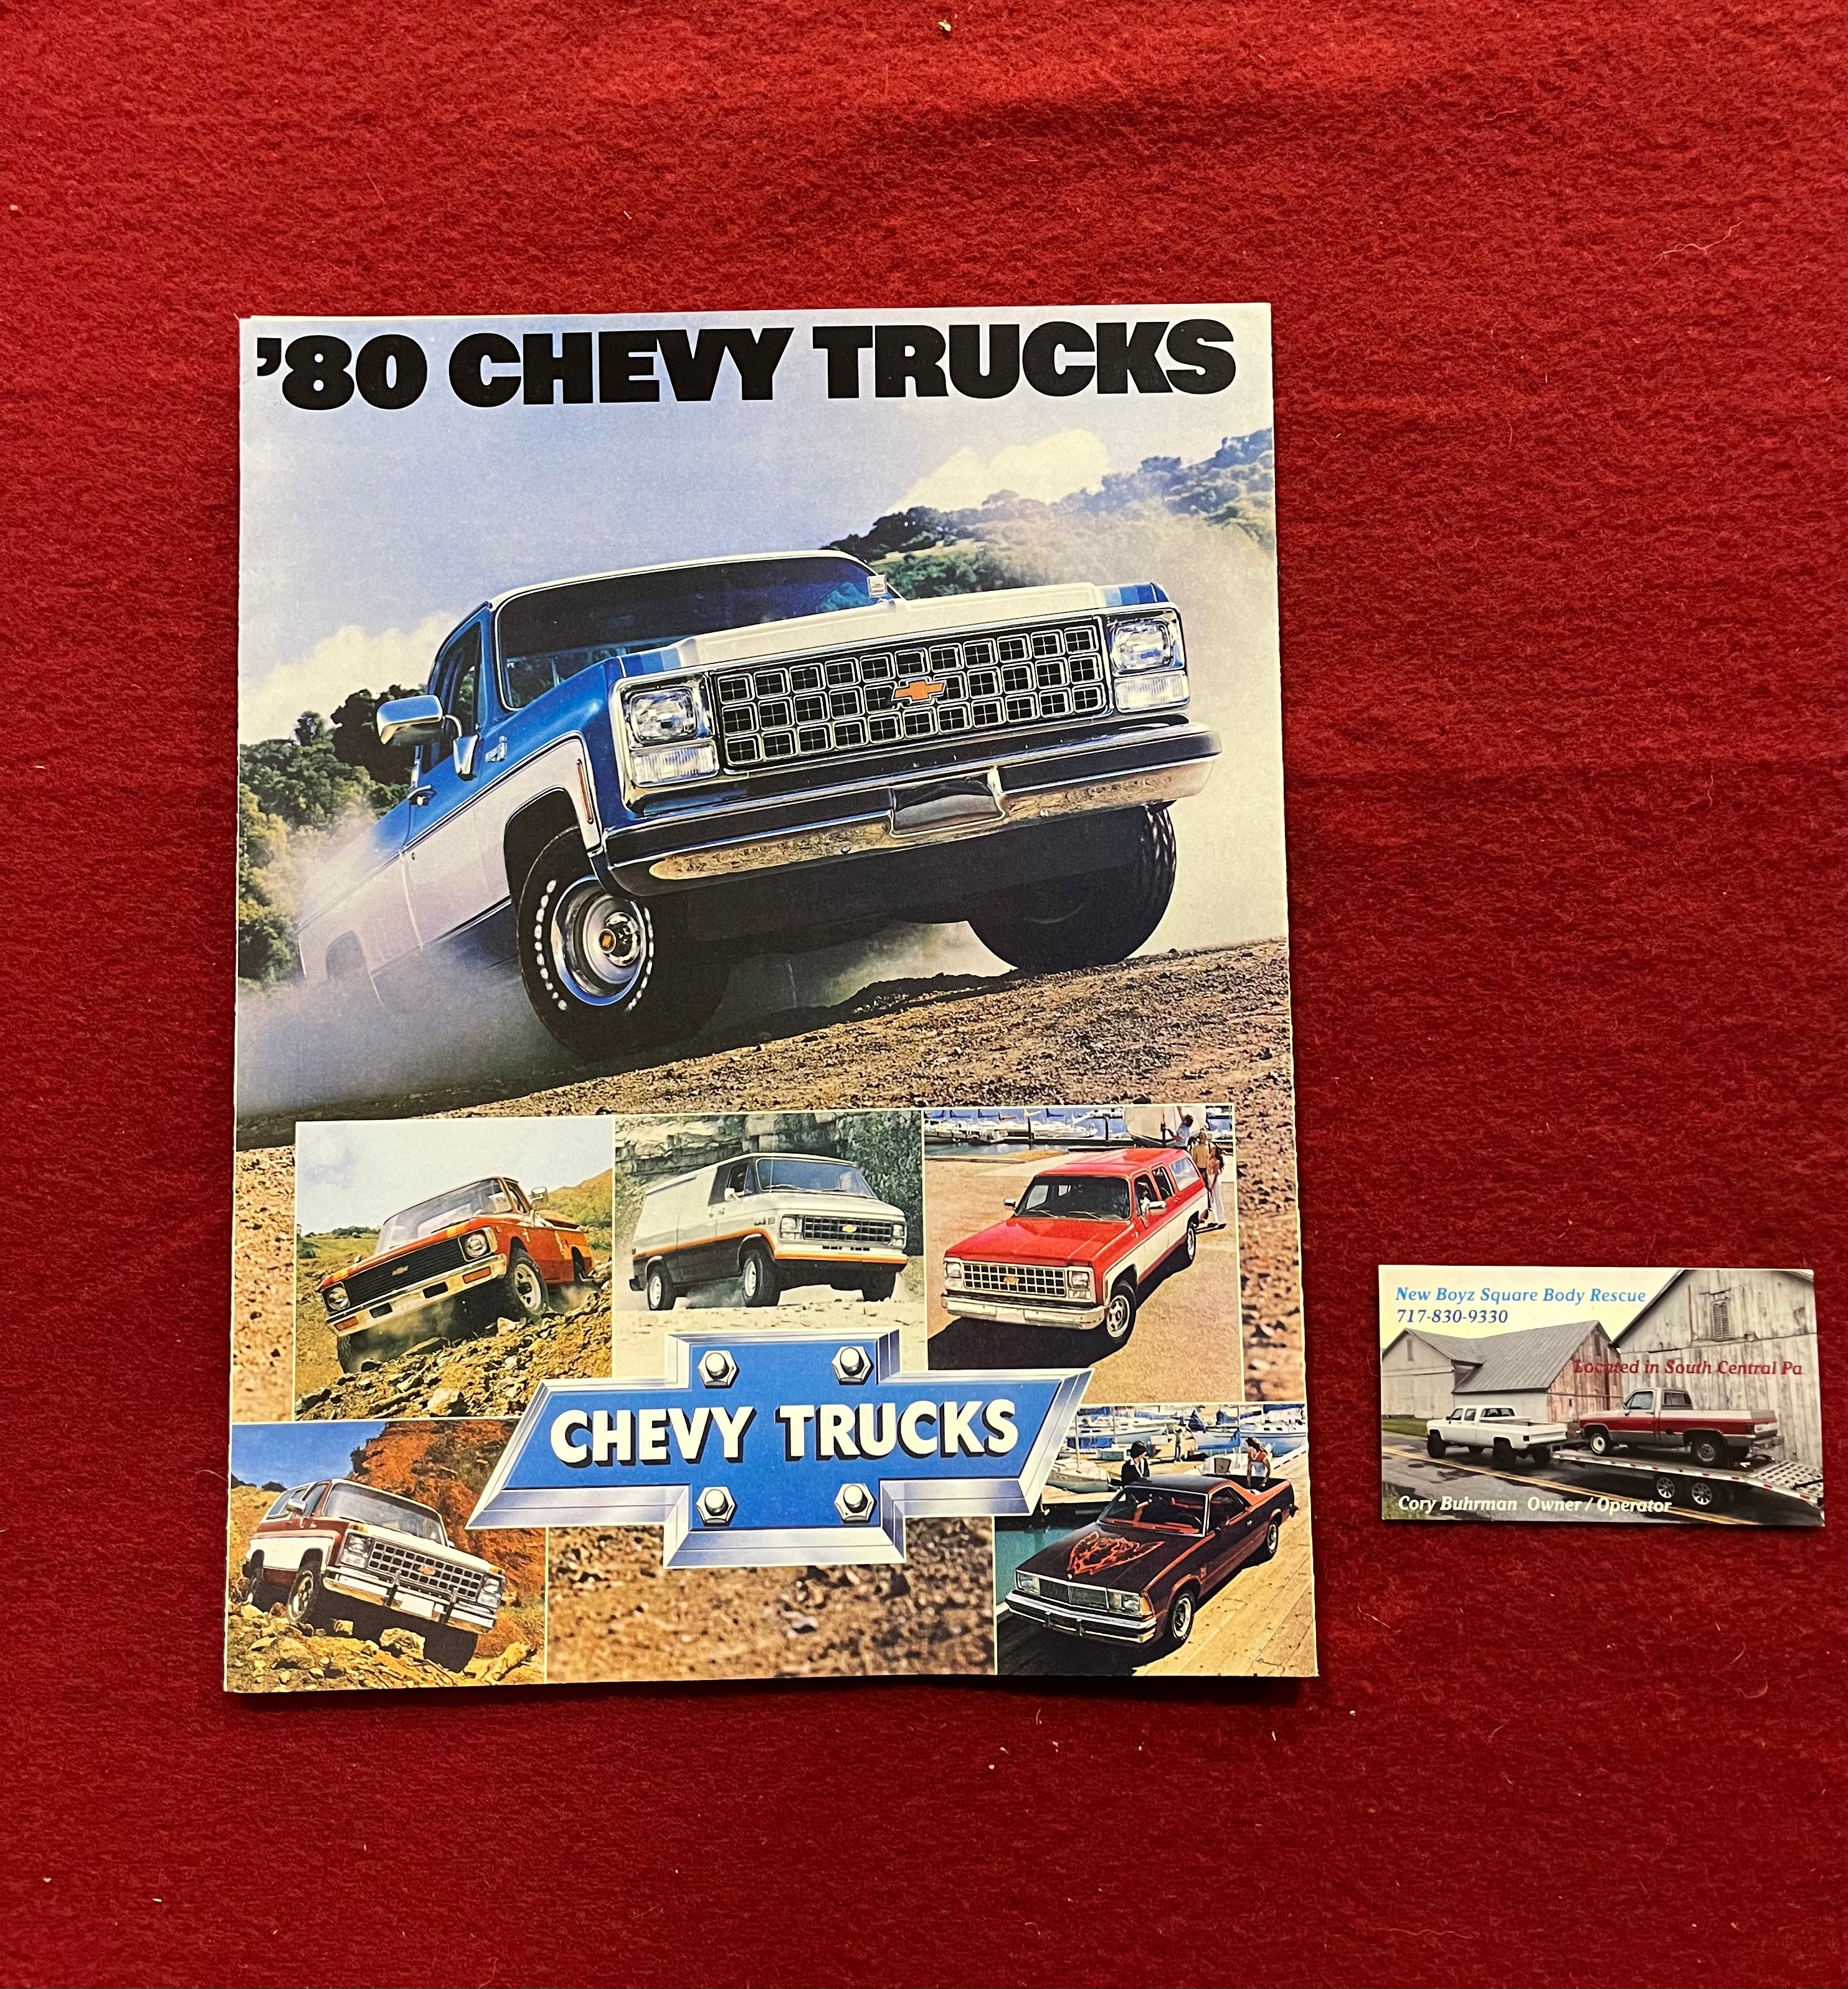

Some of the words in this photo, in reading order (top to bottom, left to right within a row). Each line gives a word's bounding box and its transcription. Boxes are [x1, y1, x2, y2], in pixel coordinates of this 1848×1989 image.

[257, 334, 427, 411] '80
[448, 328, 794, 408] CHEVY
[812, 318, 1236, 399] TRUCKS
[1395, 1287, 1430, 1302] New
[1436, 1288, 1476, 1304] Boyz
[1480, 1288, 1538, 1304] Square
[1543, 1288, 1585, 1304] Body
[1590, 1289, 1646, 1303] Rescue
[1396, 1309, 1508, 1324] 717-830-9330
[1573, 1359, 1640, 1374] Located
[1645, 1360, 1660, 1374] in
[1664, 1360, 1713, 1375] South
[1717, 1361, 1777, 1375] Central
[1781, 1361, 1803, 1375] Pa
[551, 1406, 756, 1467] CHEVY
[776, 1400, 1019, 1461] TRUCKS
[1398, 1496, 1436, 1514] Cory
[1441, 1497, 1517, 1512] Buhrman
[1527, 1498, 1581, 1512] Owner
[1597, 1499, 1672, 1514] Operator
